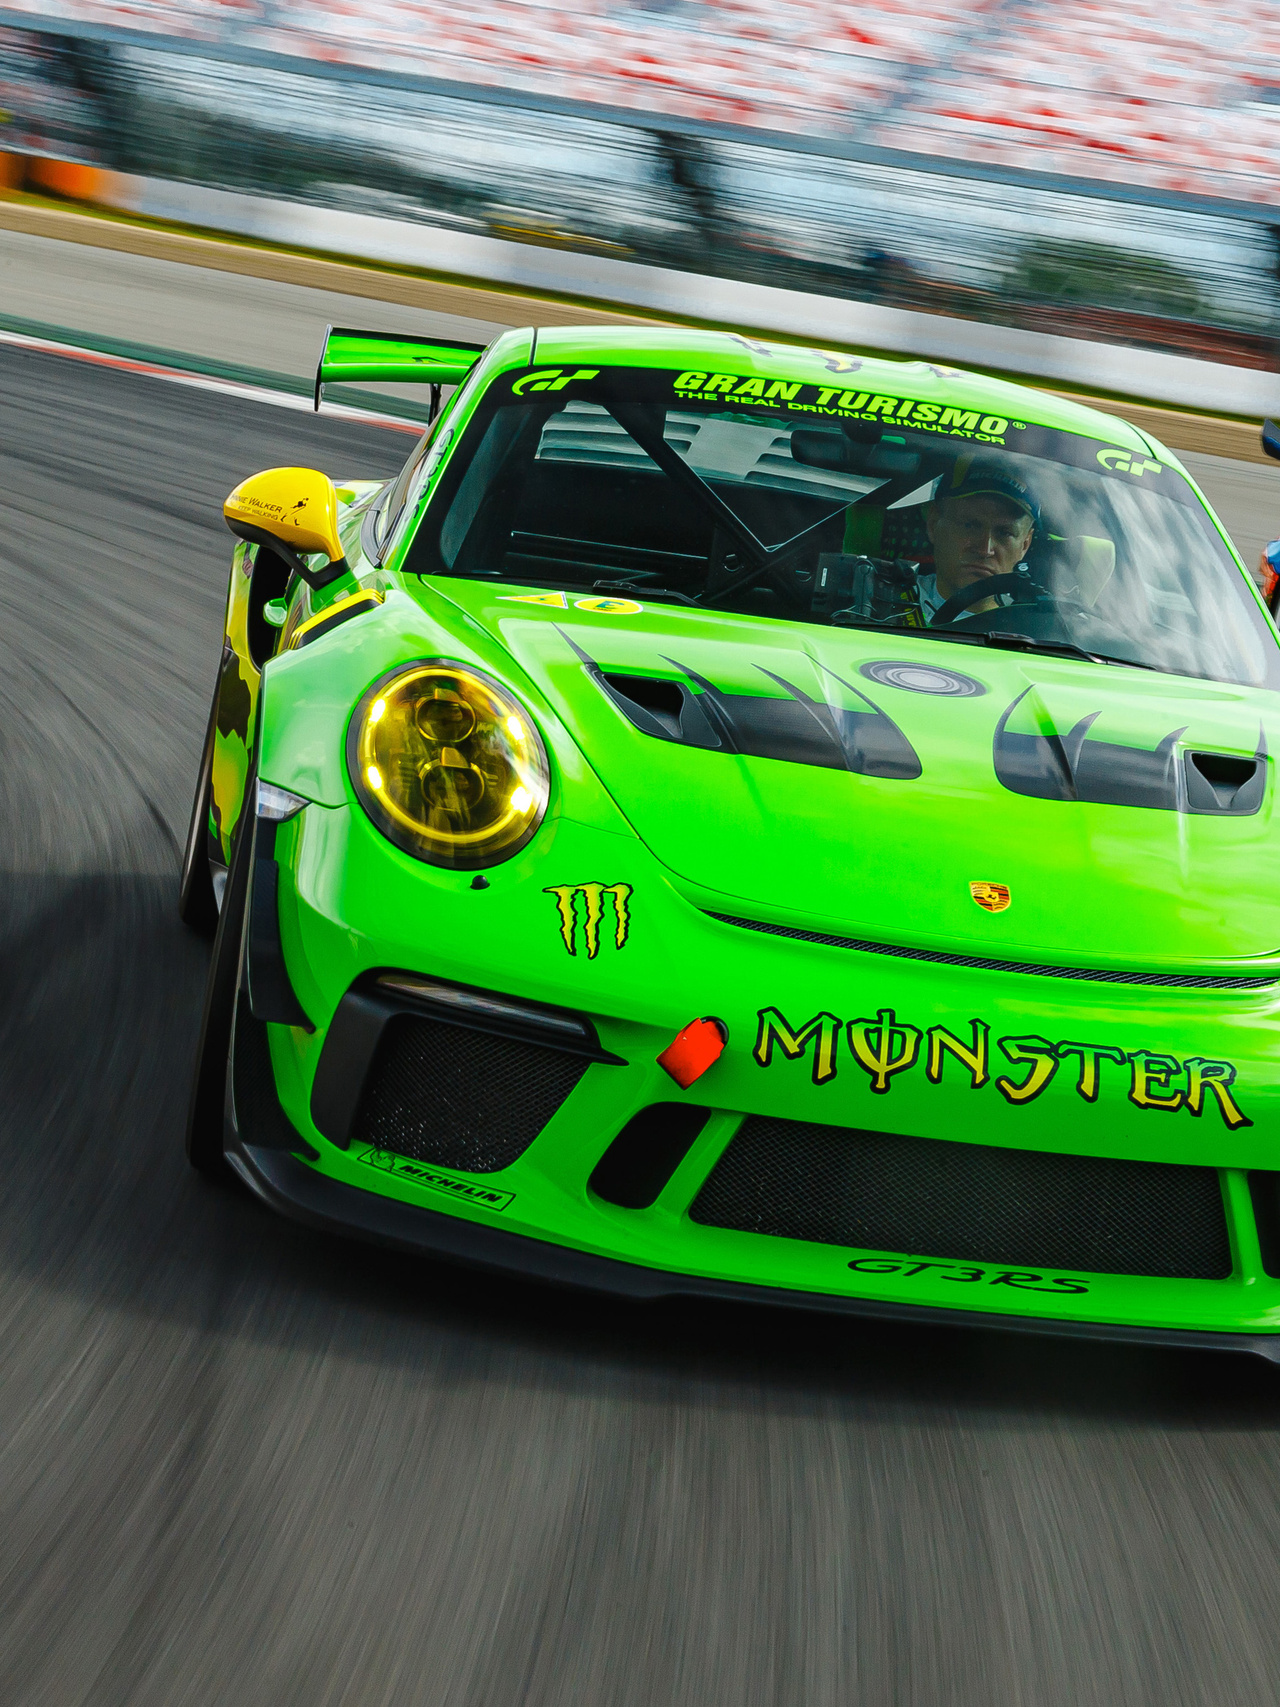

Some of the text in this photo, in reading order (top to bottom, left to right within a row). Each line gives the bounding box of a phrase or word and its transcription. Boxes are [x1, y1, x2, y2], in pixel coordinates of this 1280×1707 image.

[673, 371, 803, 401] GRAN
[674, 390, 1006, 446] THE REAL DRIVING SIMULATOR
[248, 496, 283, 513] WALKER
[251, 509, 279, 521] WALKING
[752, 1006, 1255, 1131] MONSTER
[400, 1164, 503, 1203] MICHELIN
[847, 1258, 1091, 1294] GT3RS
